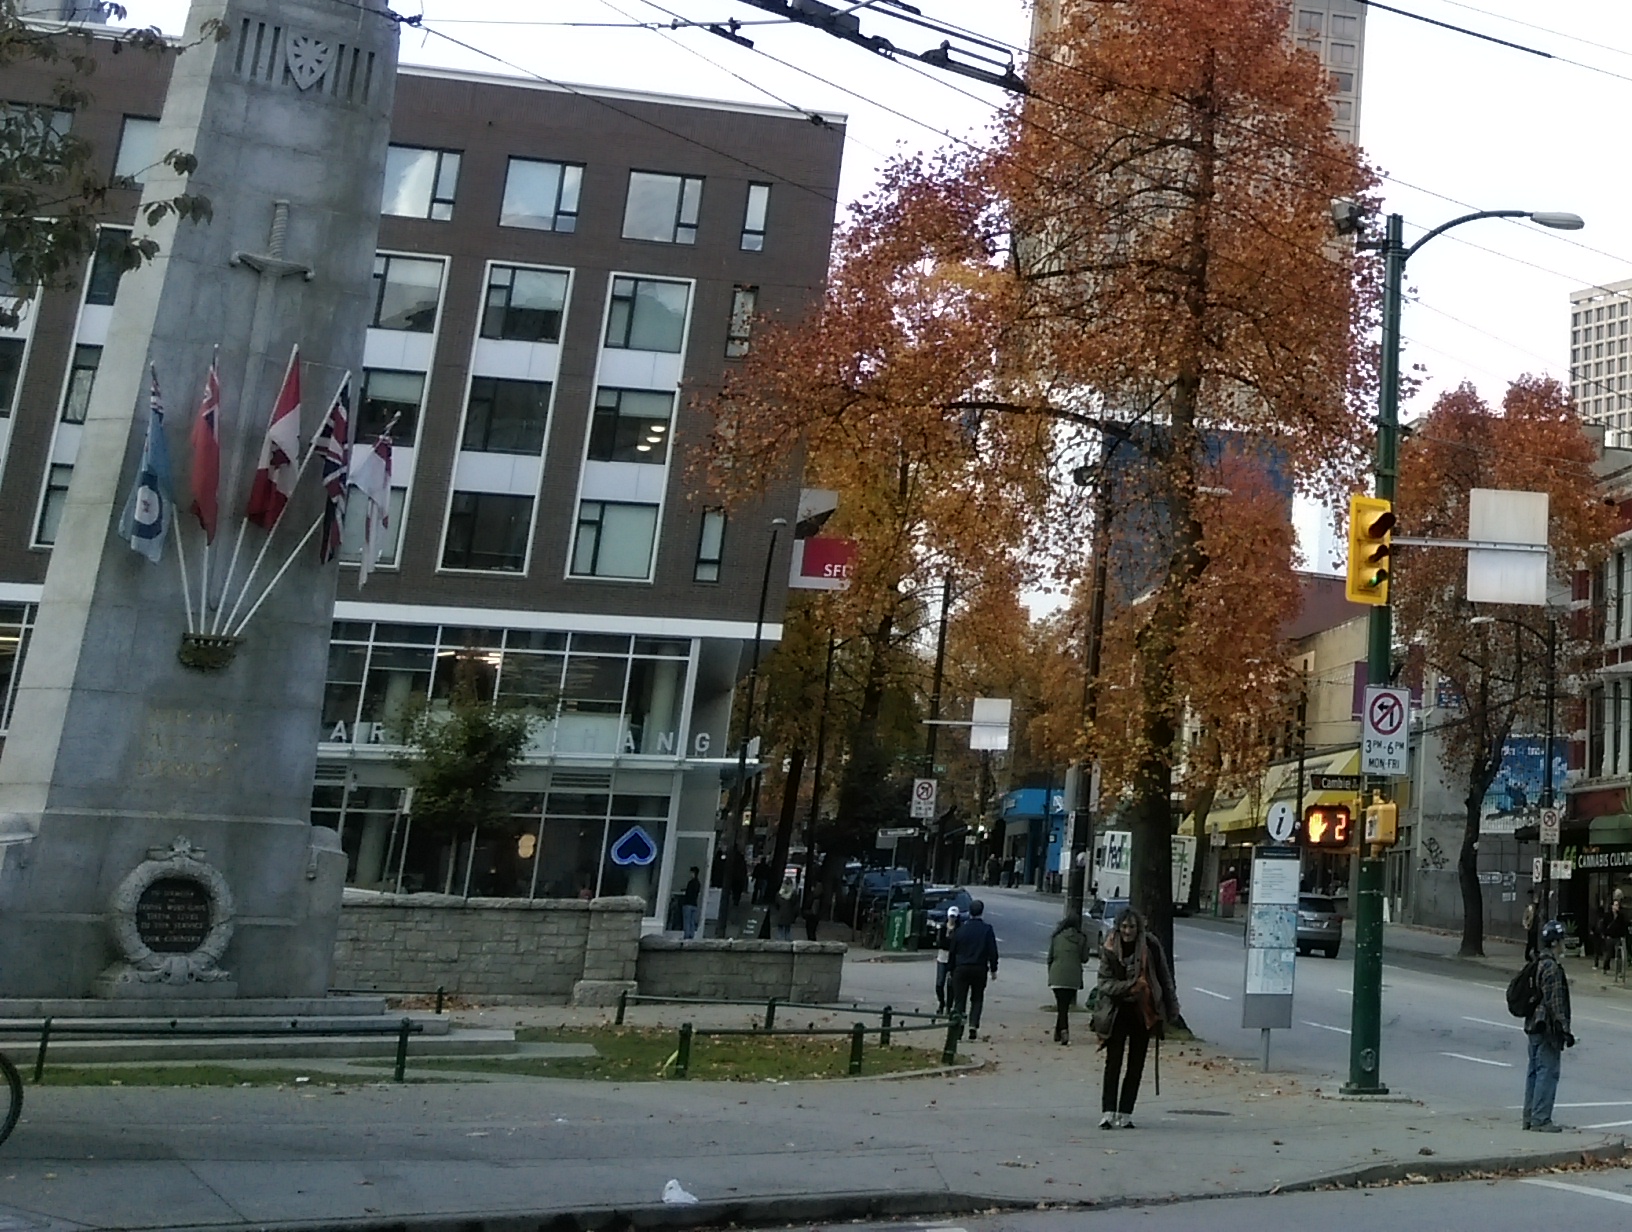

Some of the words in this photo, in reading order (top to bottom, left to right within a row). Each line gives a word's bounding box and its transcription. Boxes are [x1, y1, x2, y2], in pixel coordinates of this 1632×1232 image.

[1321, 777, 1350, 789] Cambie
[1334, 813, 1346, 840] 2
[1578, 853, 1609, 869] CANNABIS
